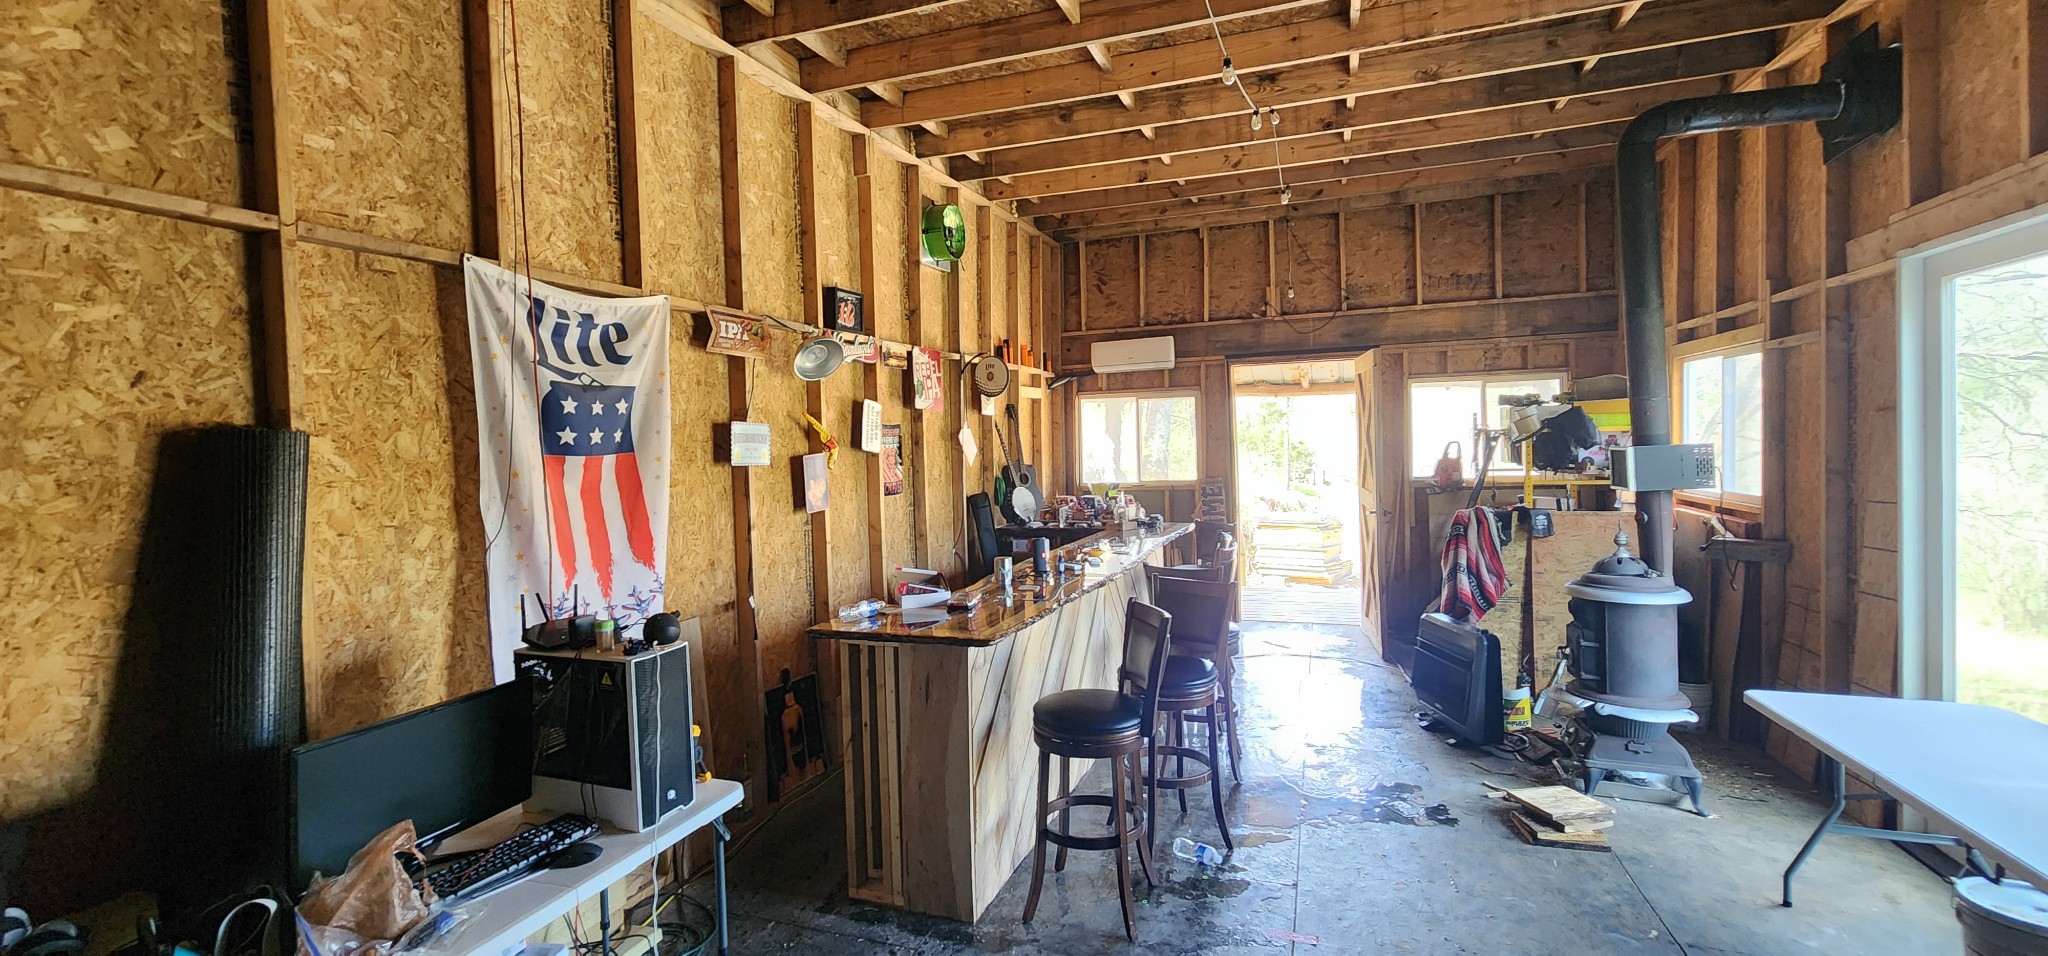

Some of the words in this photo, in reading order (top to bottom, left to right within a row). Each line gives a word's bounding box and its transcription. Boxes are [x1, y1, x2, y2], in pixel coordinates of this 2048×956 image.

[521, 291, 633, 380] Lite
[719, 320, 750, 341] IPA
[915, 360, 941, 378] REBEL
[985, 363, 996, 371] Lite
[922, 376, 941, 401] IPA
